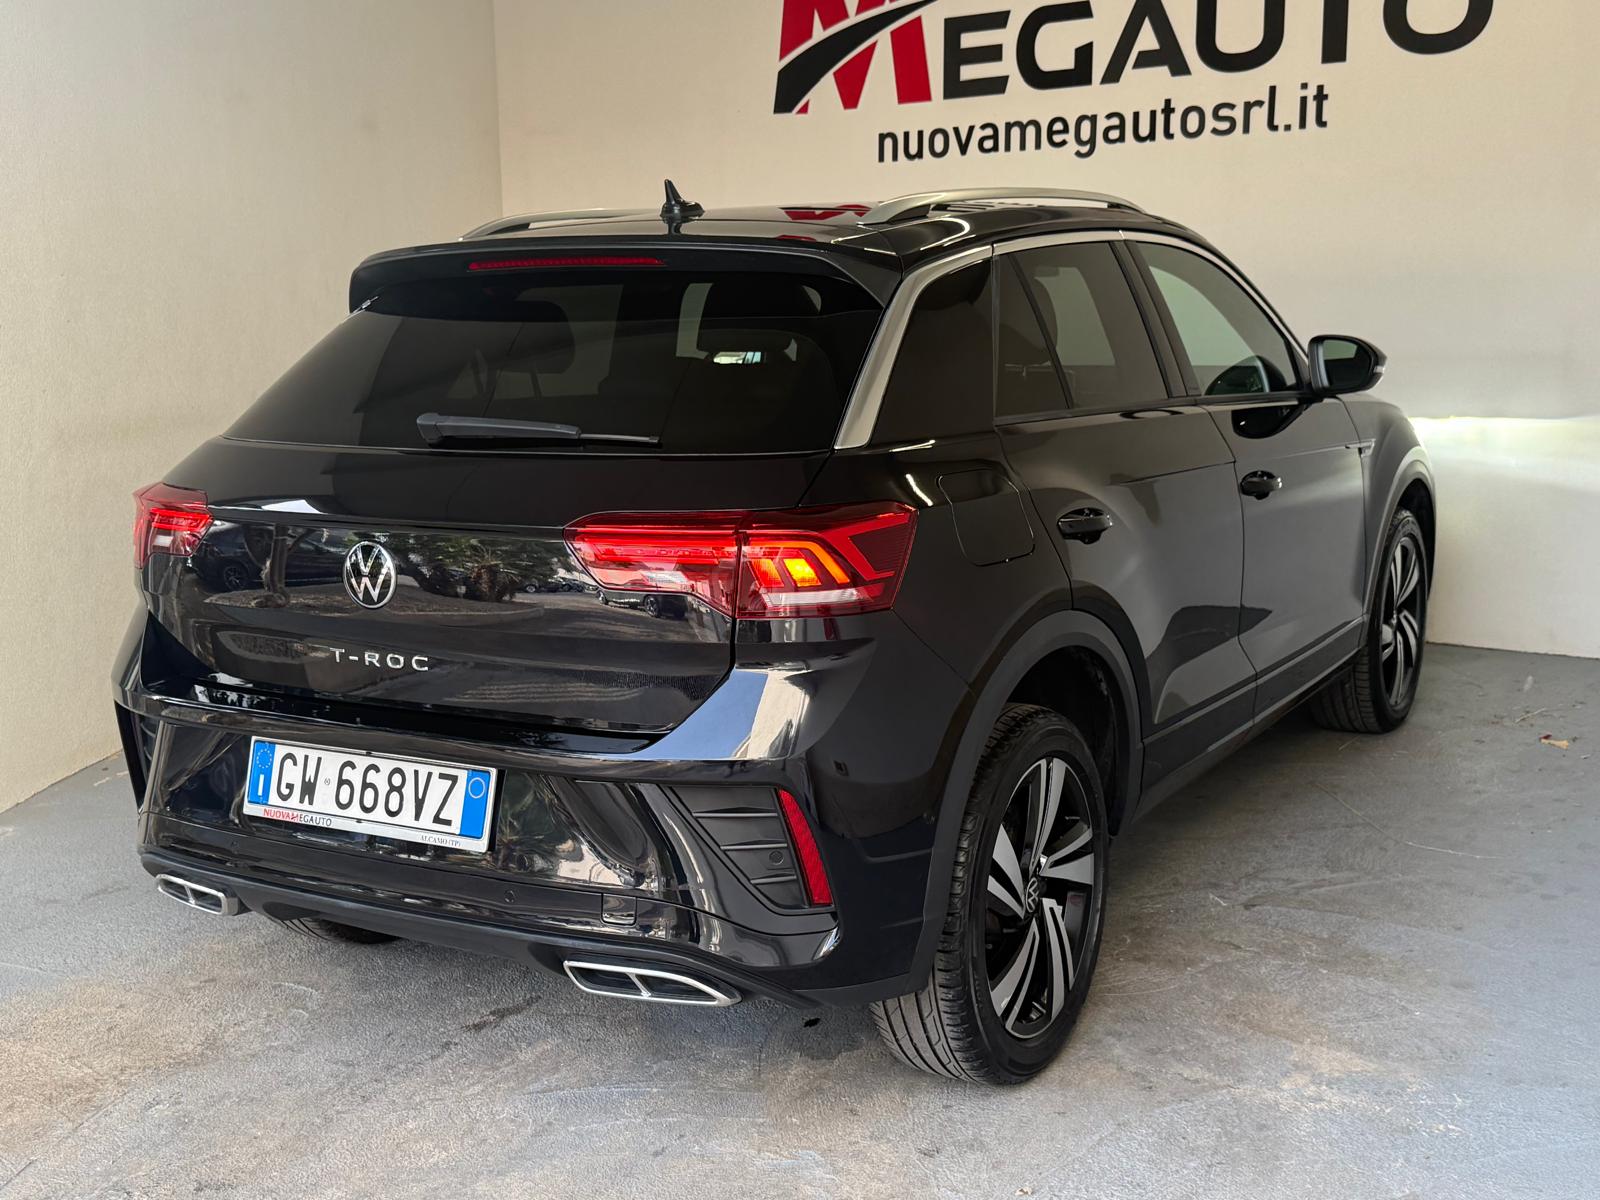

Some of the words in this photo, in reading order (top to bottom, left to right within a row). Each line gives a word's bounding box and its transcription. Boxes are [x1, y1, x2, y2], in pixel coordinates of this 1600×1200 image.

[877, 82, 1329, 162] nuovamegautosrl.it
[329, 647, 429, 671] T-ROC
[276, 752, 322, 806] GW
[334, 760, 459, 827] 668VZ
